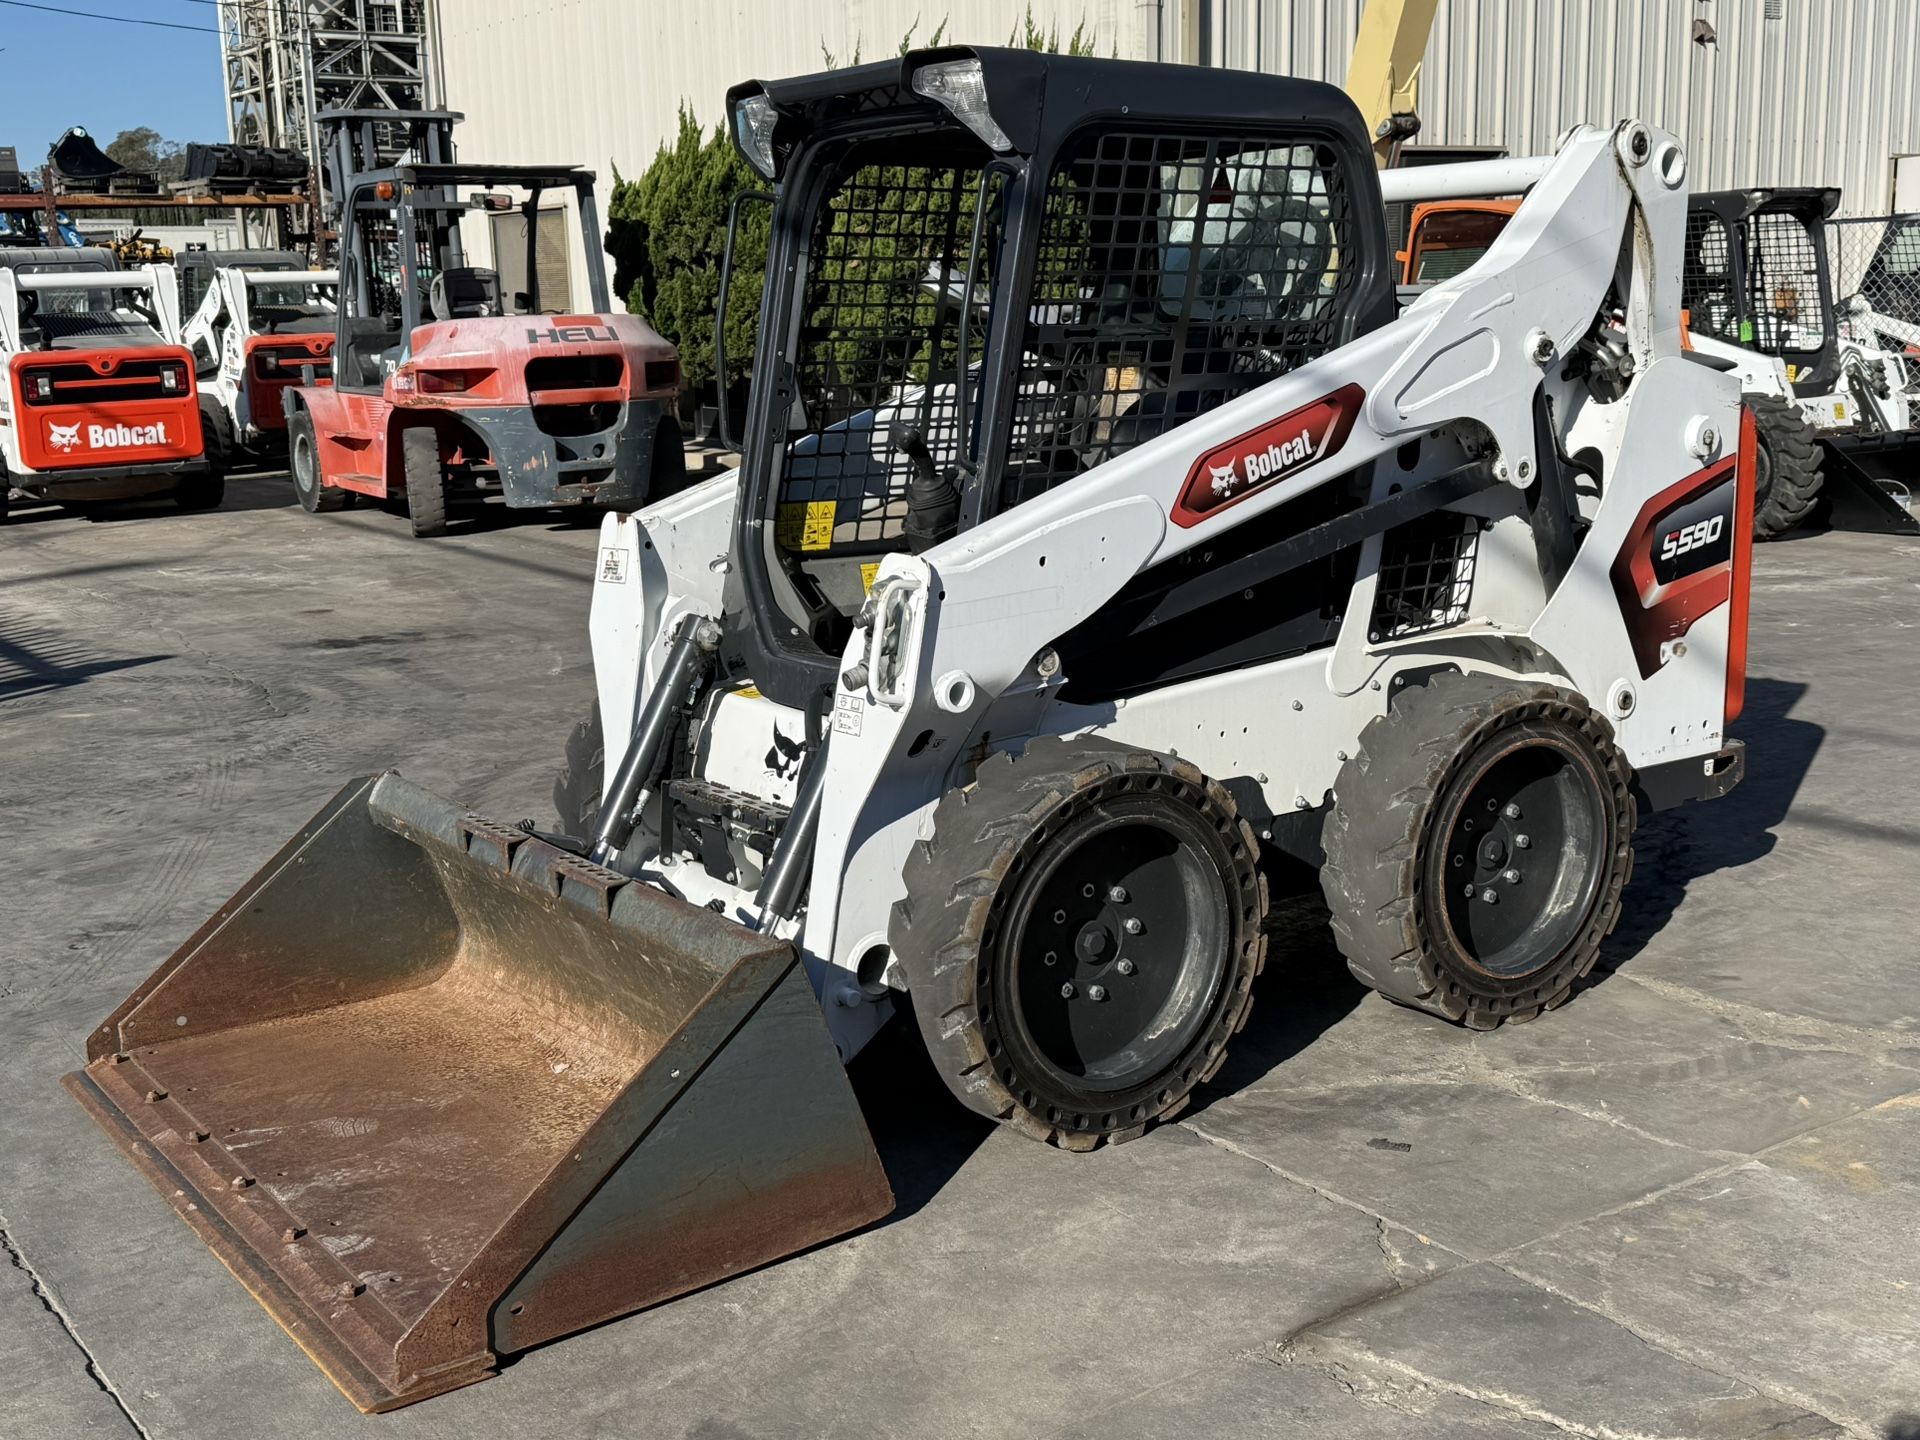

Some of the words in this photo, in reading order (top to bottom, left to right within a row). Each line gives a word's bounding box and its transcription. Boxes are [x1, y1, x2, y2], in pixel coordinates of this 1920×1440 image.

[527, 326, 619, 343] HELI
[385, 360, 396, 373] 70
[88, 422, 166, 448] Bobcat
[1244, 429, 1313, 484] Bobcat
[1661, 515, 1723, 561] S590
